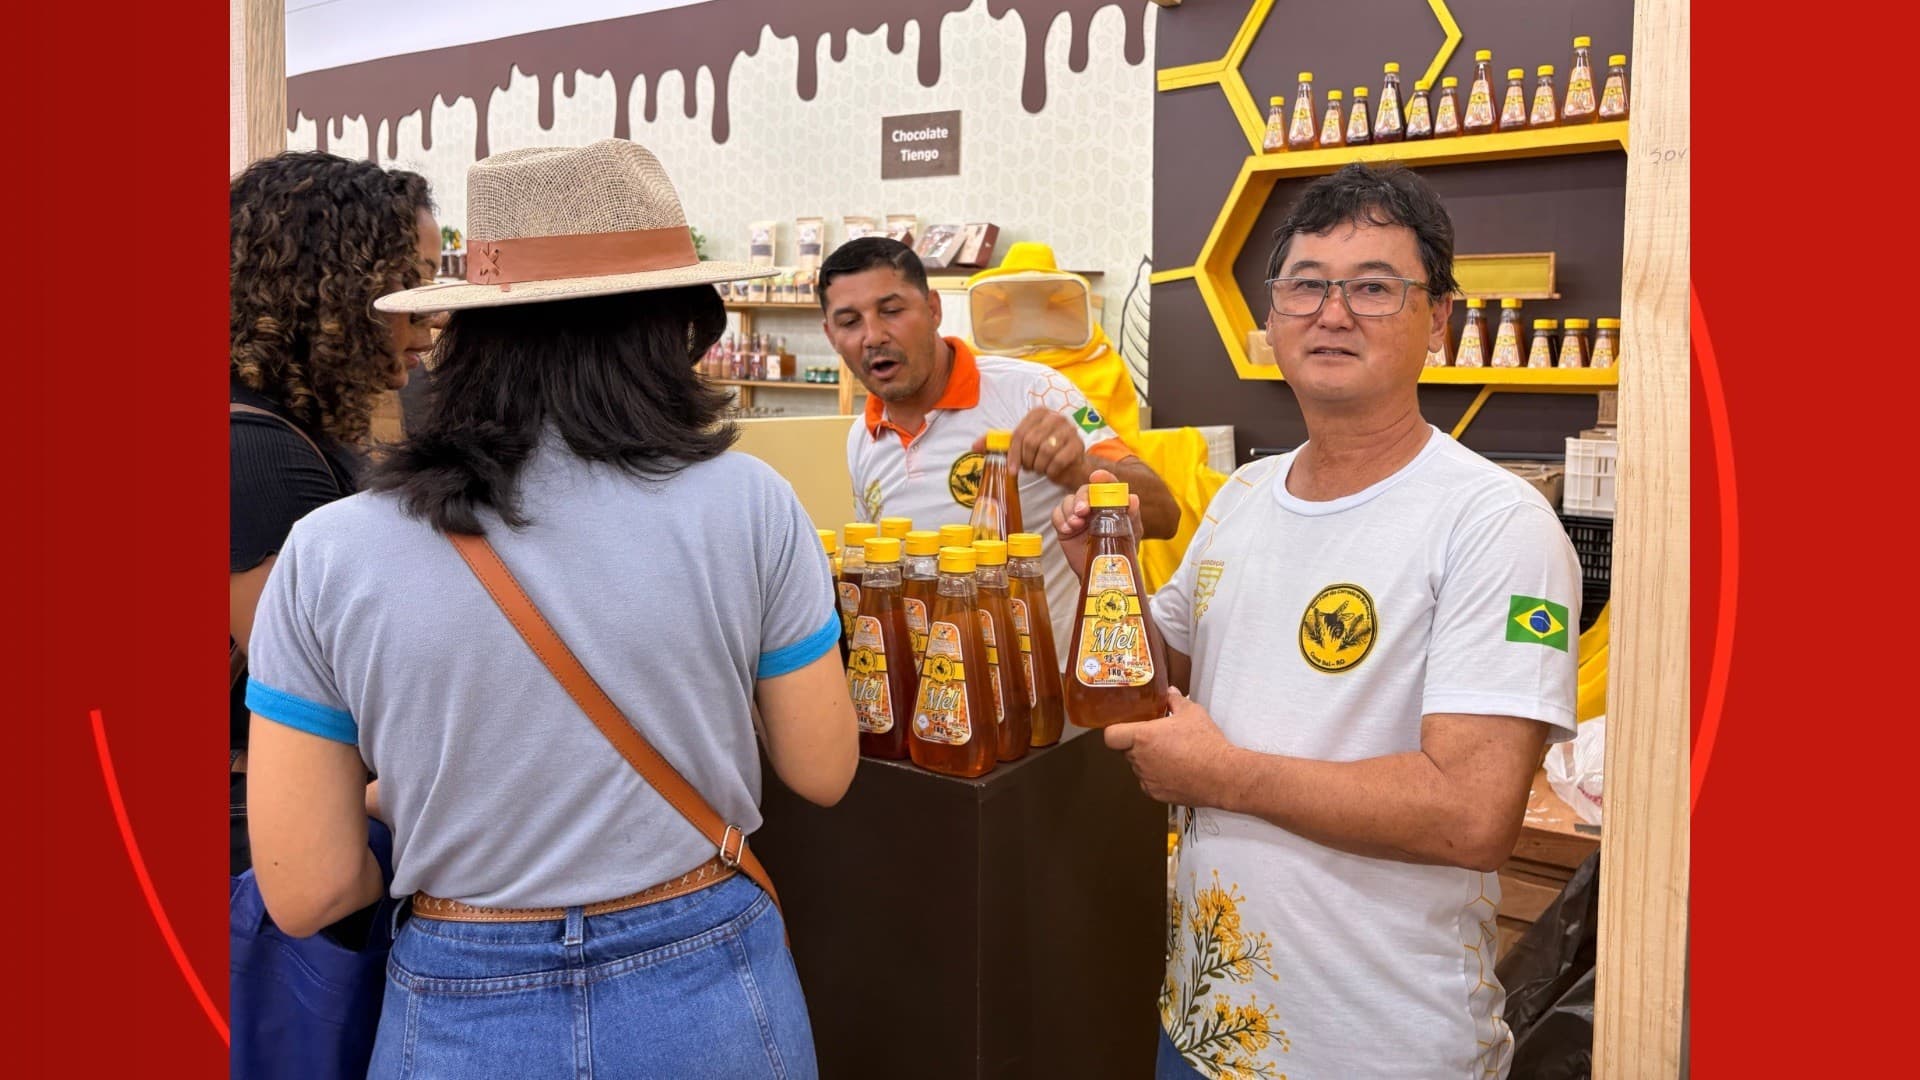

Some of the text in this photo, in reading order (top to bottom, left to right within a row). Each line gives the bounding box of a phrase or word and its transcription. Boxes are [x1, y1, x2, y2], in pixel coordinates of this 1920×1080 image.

[892, 127, 949, 143] Chocolate
[900, 149, 939, 162] Tiengo
[1090, 625, 1138, 652] Mel
[925, 687, 960, 711] Mel
